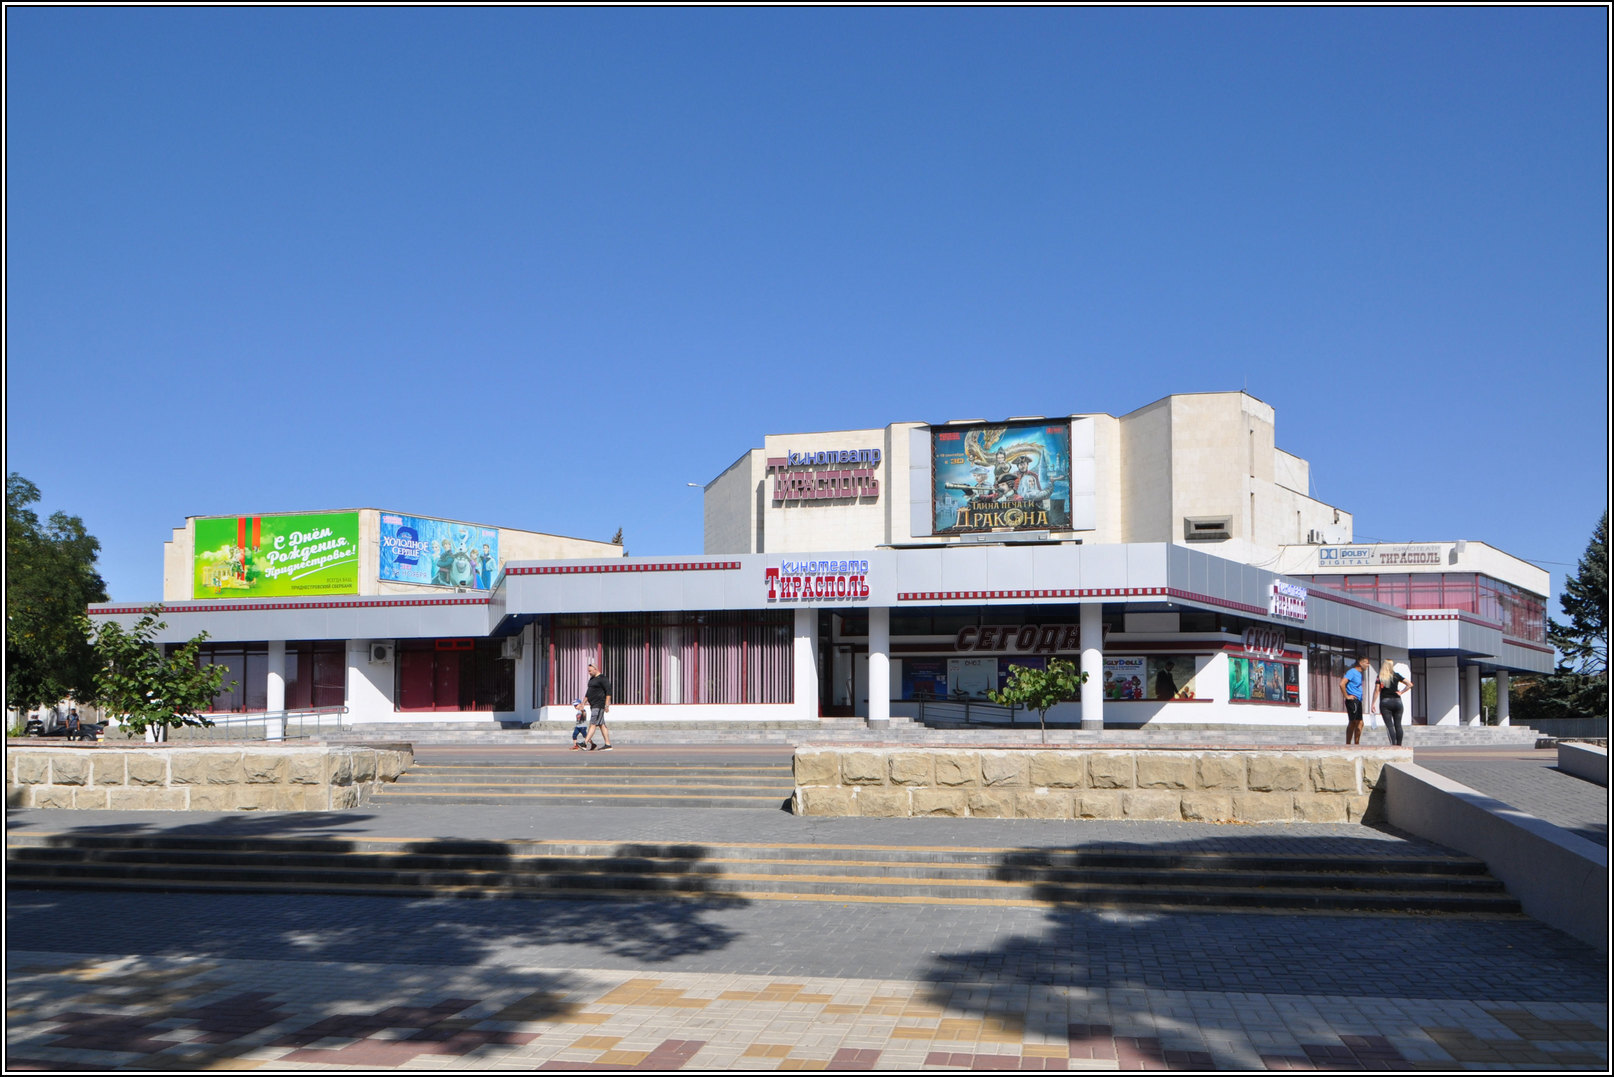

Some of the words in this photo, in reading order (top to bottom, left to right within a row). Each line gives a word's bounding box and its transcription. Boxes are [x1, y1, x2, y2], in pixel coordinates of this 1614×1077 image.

[1001, 500, 1035, 510] ПЕЧАТИ
[952, 506, 1048, 529] ДРАКОНА
[288, 528, 333, 547] Днём
[383, 536, 430, 553] ХОЛОДНОЕ
[392, 547, 420, 557] СЕРДЦЕ
[1380, 553, 1440, 564] ТИРАСПОЛЬ
[264, 545, 356, 580] Приднестровье!
[954, 624, 1112, 653] СЕГОДН
[1245, 627, 1286, 655] СКОРО
